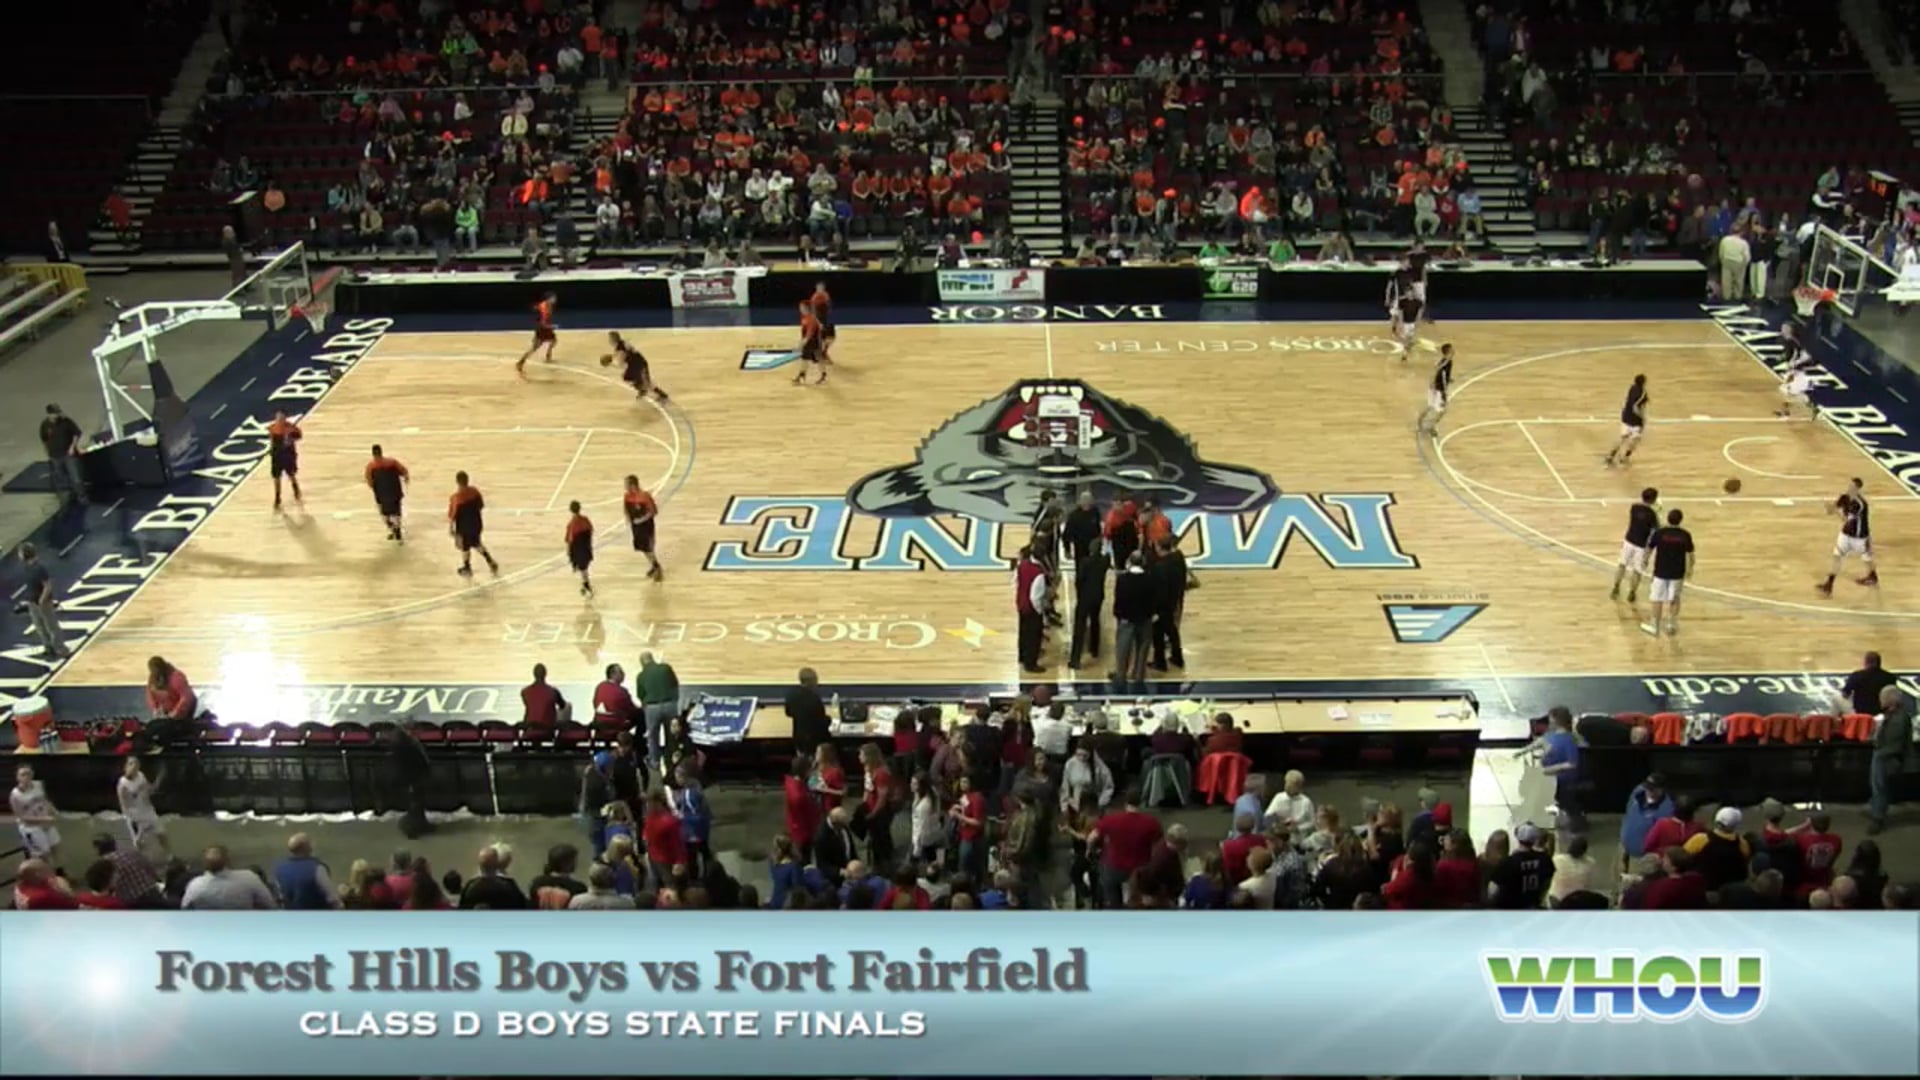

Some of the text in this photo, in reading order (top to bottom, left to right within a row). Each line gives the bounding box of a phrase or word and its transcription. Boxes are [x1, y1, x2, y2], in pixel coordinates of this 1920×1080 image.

[928, 304, 1166, 320] BANGOR
[1094, 339, 1258, 352] CENTER
[1700, 304, 1920, 493] MAIE BLA
[131, 413, 303, 532] BLACK
[268, 317, 394, 401] BEARS
[702, 494, 1420, 571] MNE
[502, 621, 729, 643] CENTER
